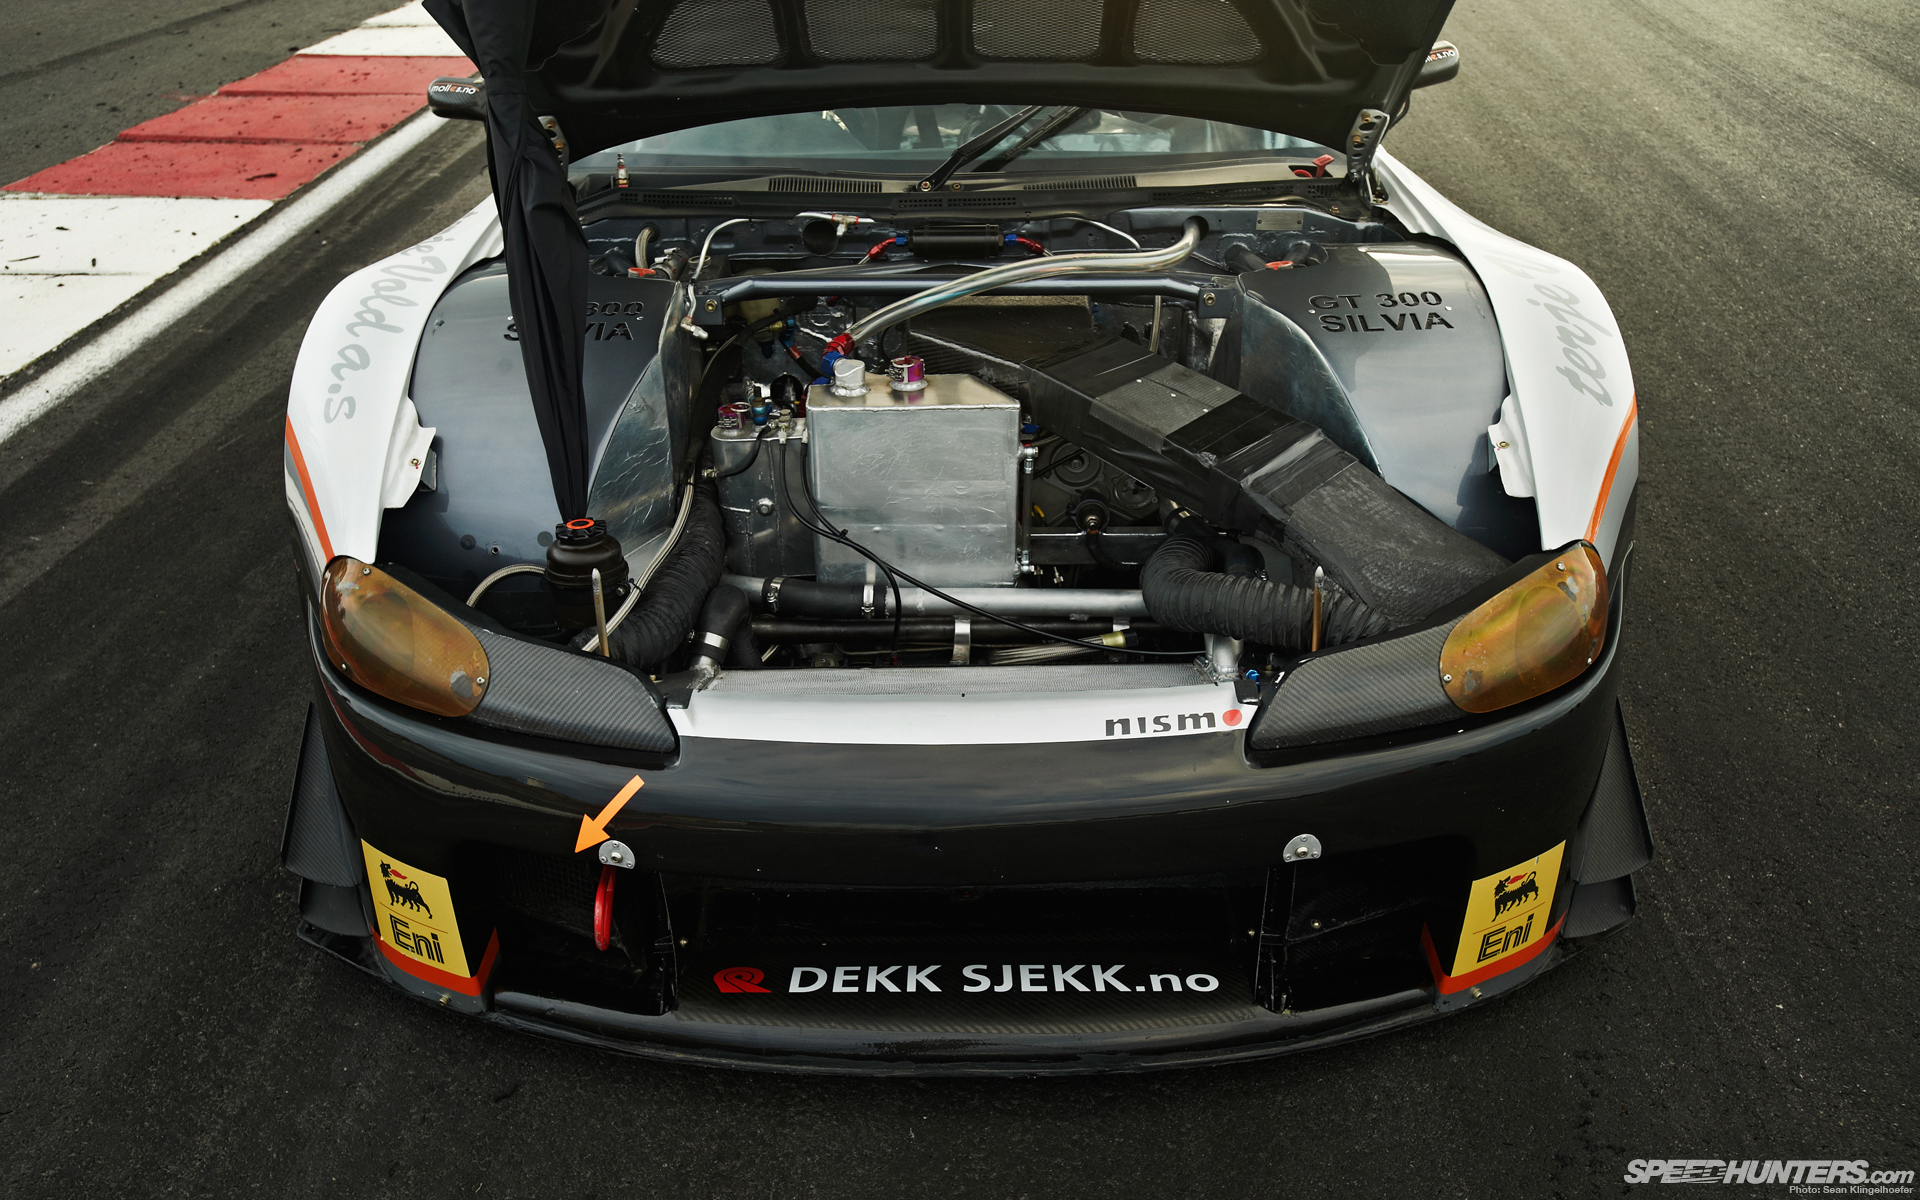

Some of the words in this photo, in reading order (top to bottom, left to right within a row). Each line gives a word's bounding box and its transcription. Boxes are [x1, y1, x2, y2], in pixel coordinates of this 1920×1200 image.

[1424, 50, 1456, 63] lles.no
[431, 84, 477, 94] molles.no
[1308, 294, 1361, 310] GT
[1374, 291, 1443, 308] 300
[1318, 312, 1454, 333] SILVIA
[389, 913, 445, 965] Eni
[1476, 913, 1535, 964] Eni
[788, 965, 943, 993] DEKK
[962, 964, 1220, 993] SJEKK.no
